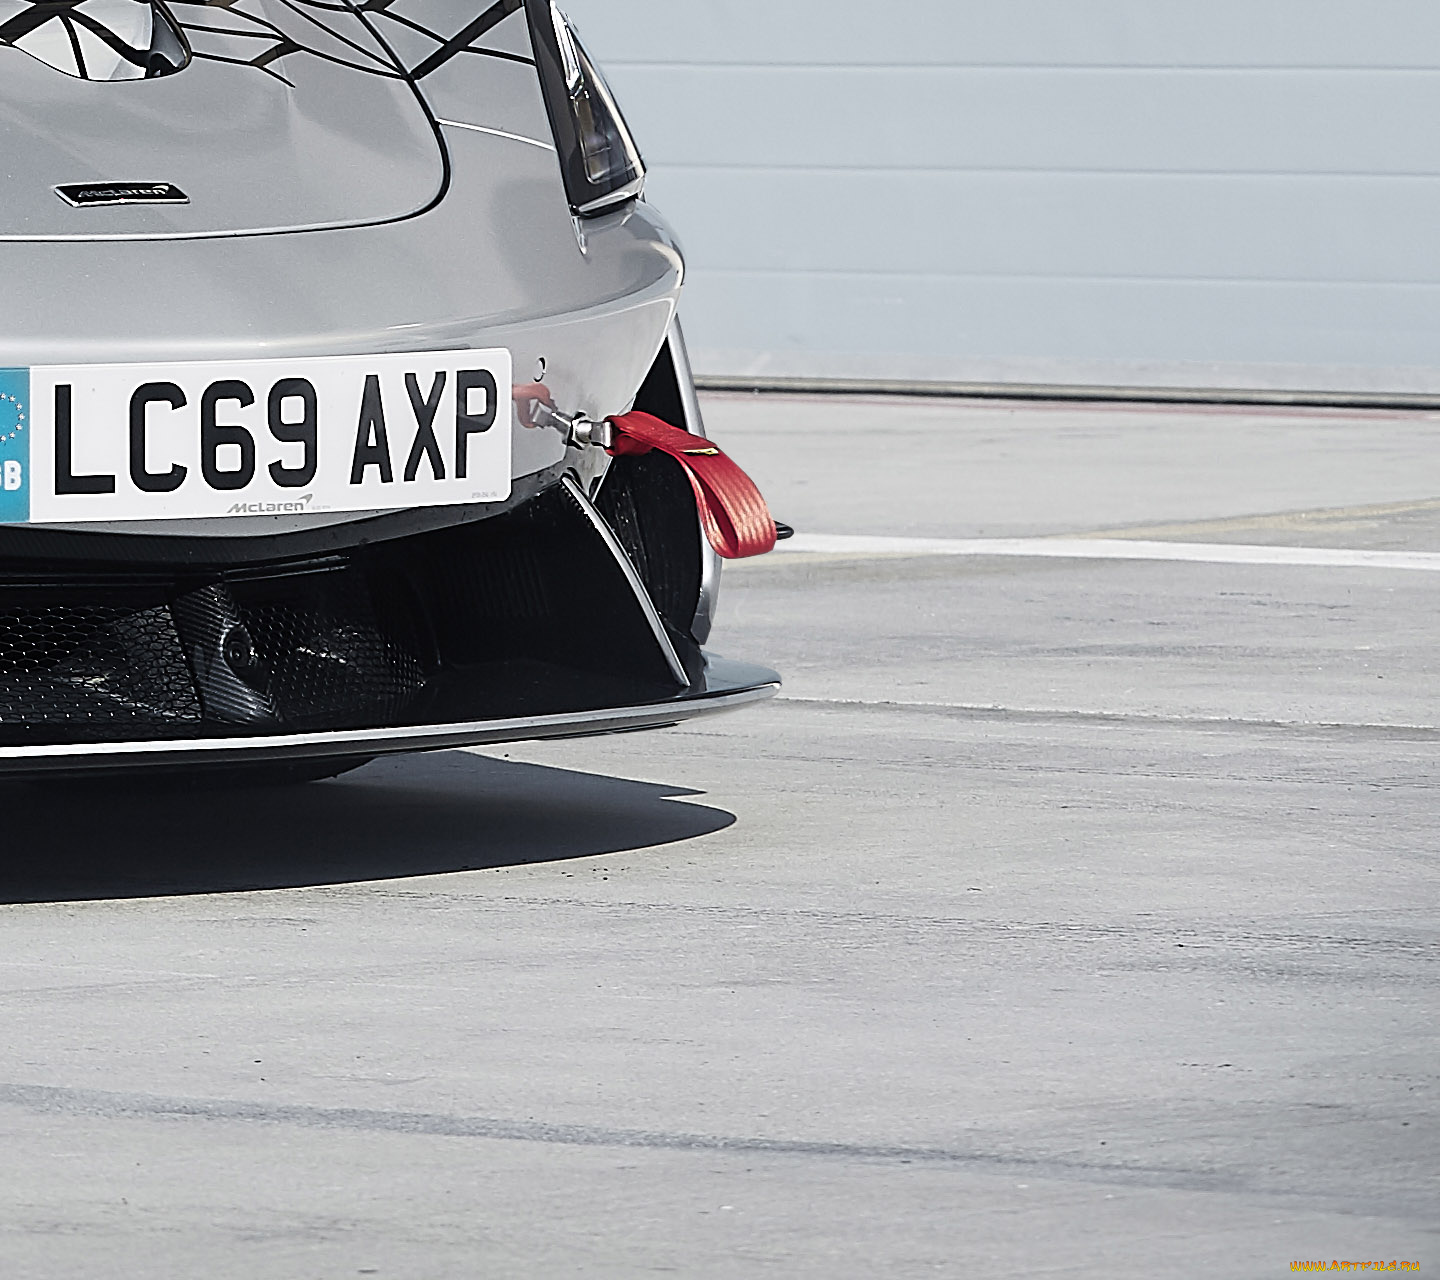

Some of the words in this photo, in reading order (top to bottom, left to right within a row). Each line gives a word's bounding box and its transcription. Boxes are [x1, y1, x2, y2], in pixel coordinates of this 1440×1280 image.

[53, 376, 319, 496] LC69
[349, 368, 499, 486] AXP
[226, 501, 304, 514] McLaren
